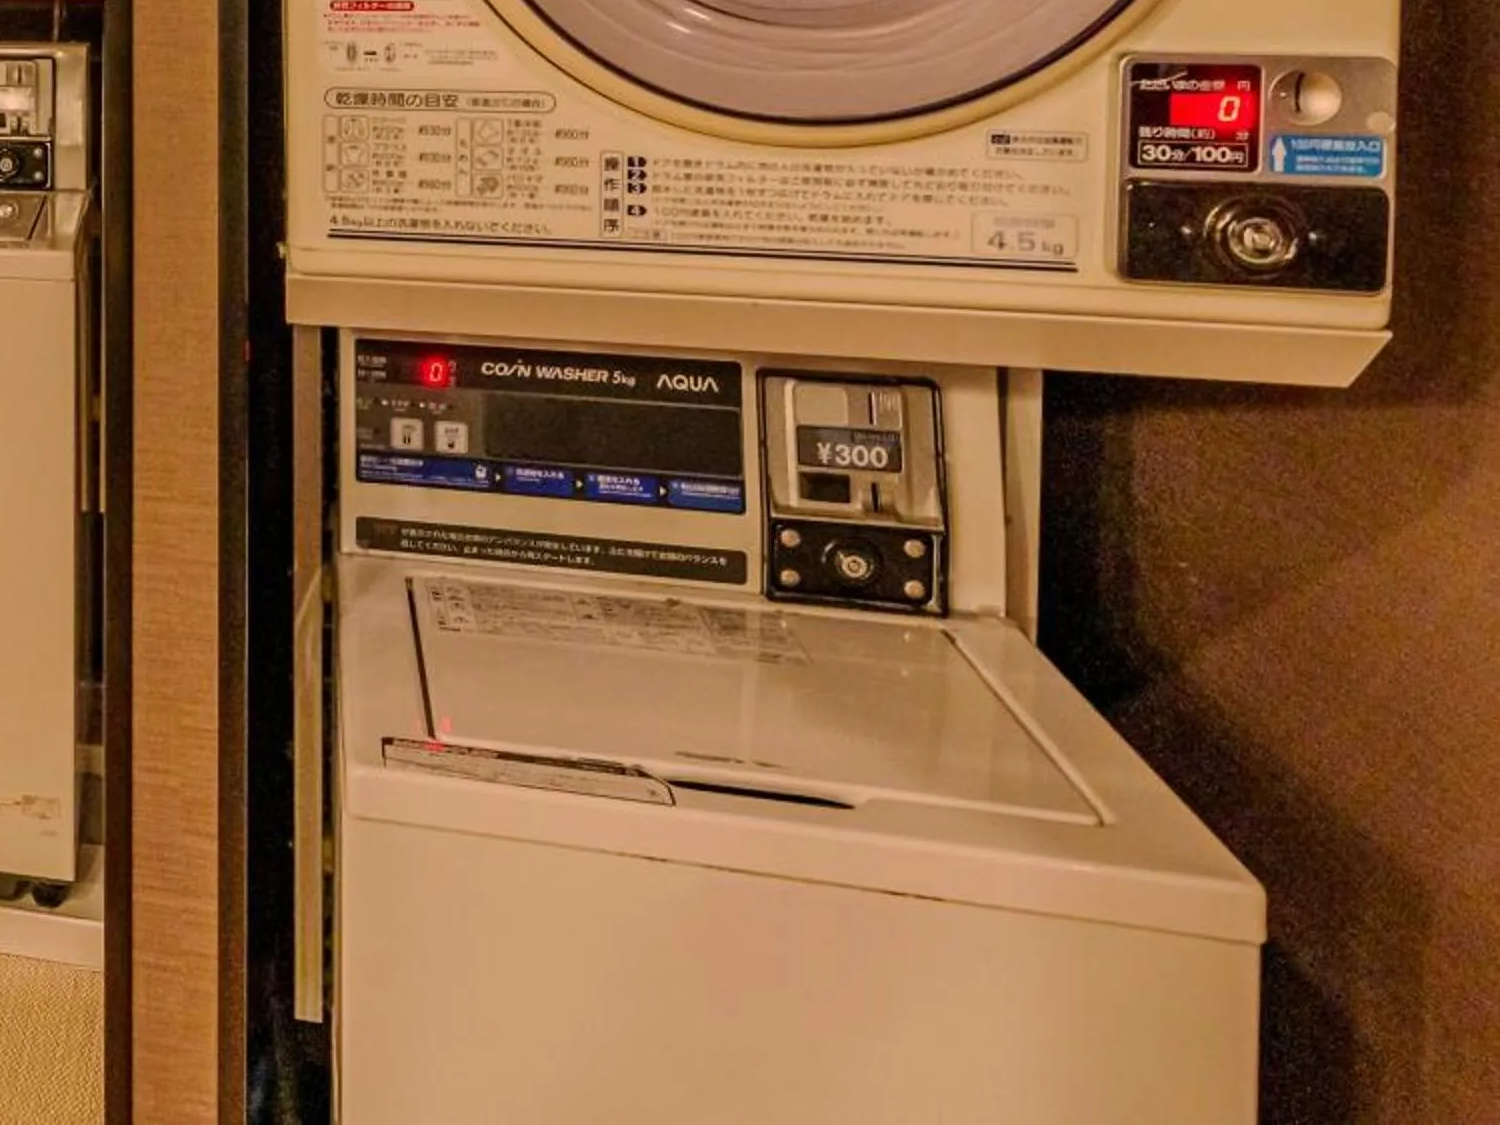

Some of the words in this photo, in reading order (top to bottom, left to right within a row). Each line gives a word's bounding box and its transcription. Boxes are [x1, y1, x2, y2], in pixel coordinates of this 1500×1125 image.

[1216, 95, 1241, 123] 0
[535, 364, 609, 383] WASHER
[611, 370, 636, 388] 5kg
[656, 373, 719, 393] AQUA
[816, 441, 889, 469] ¥300
